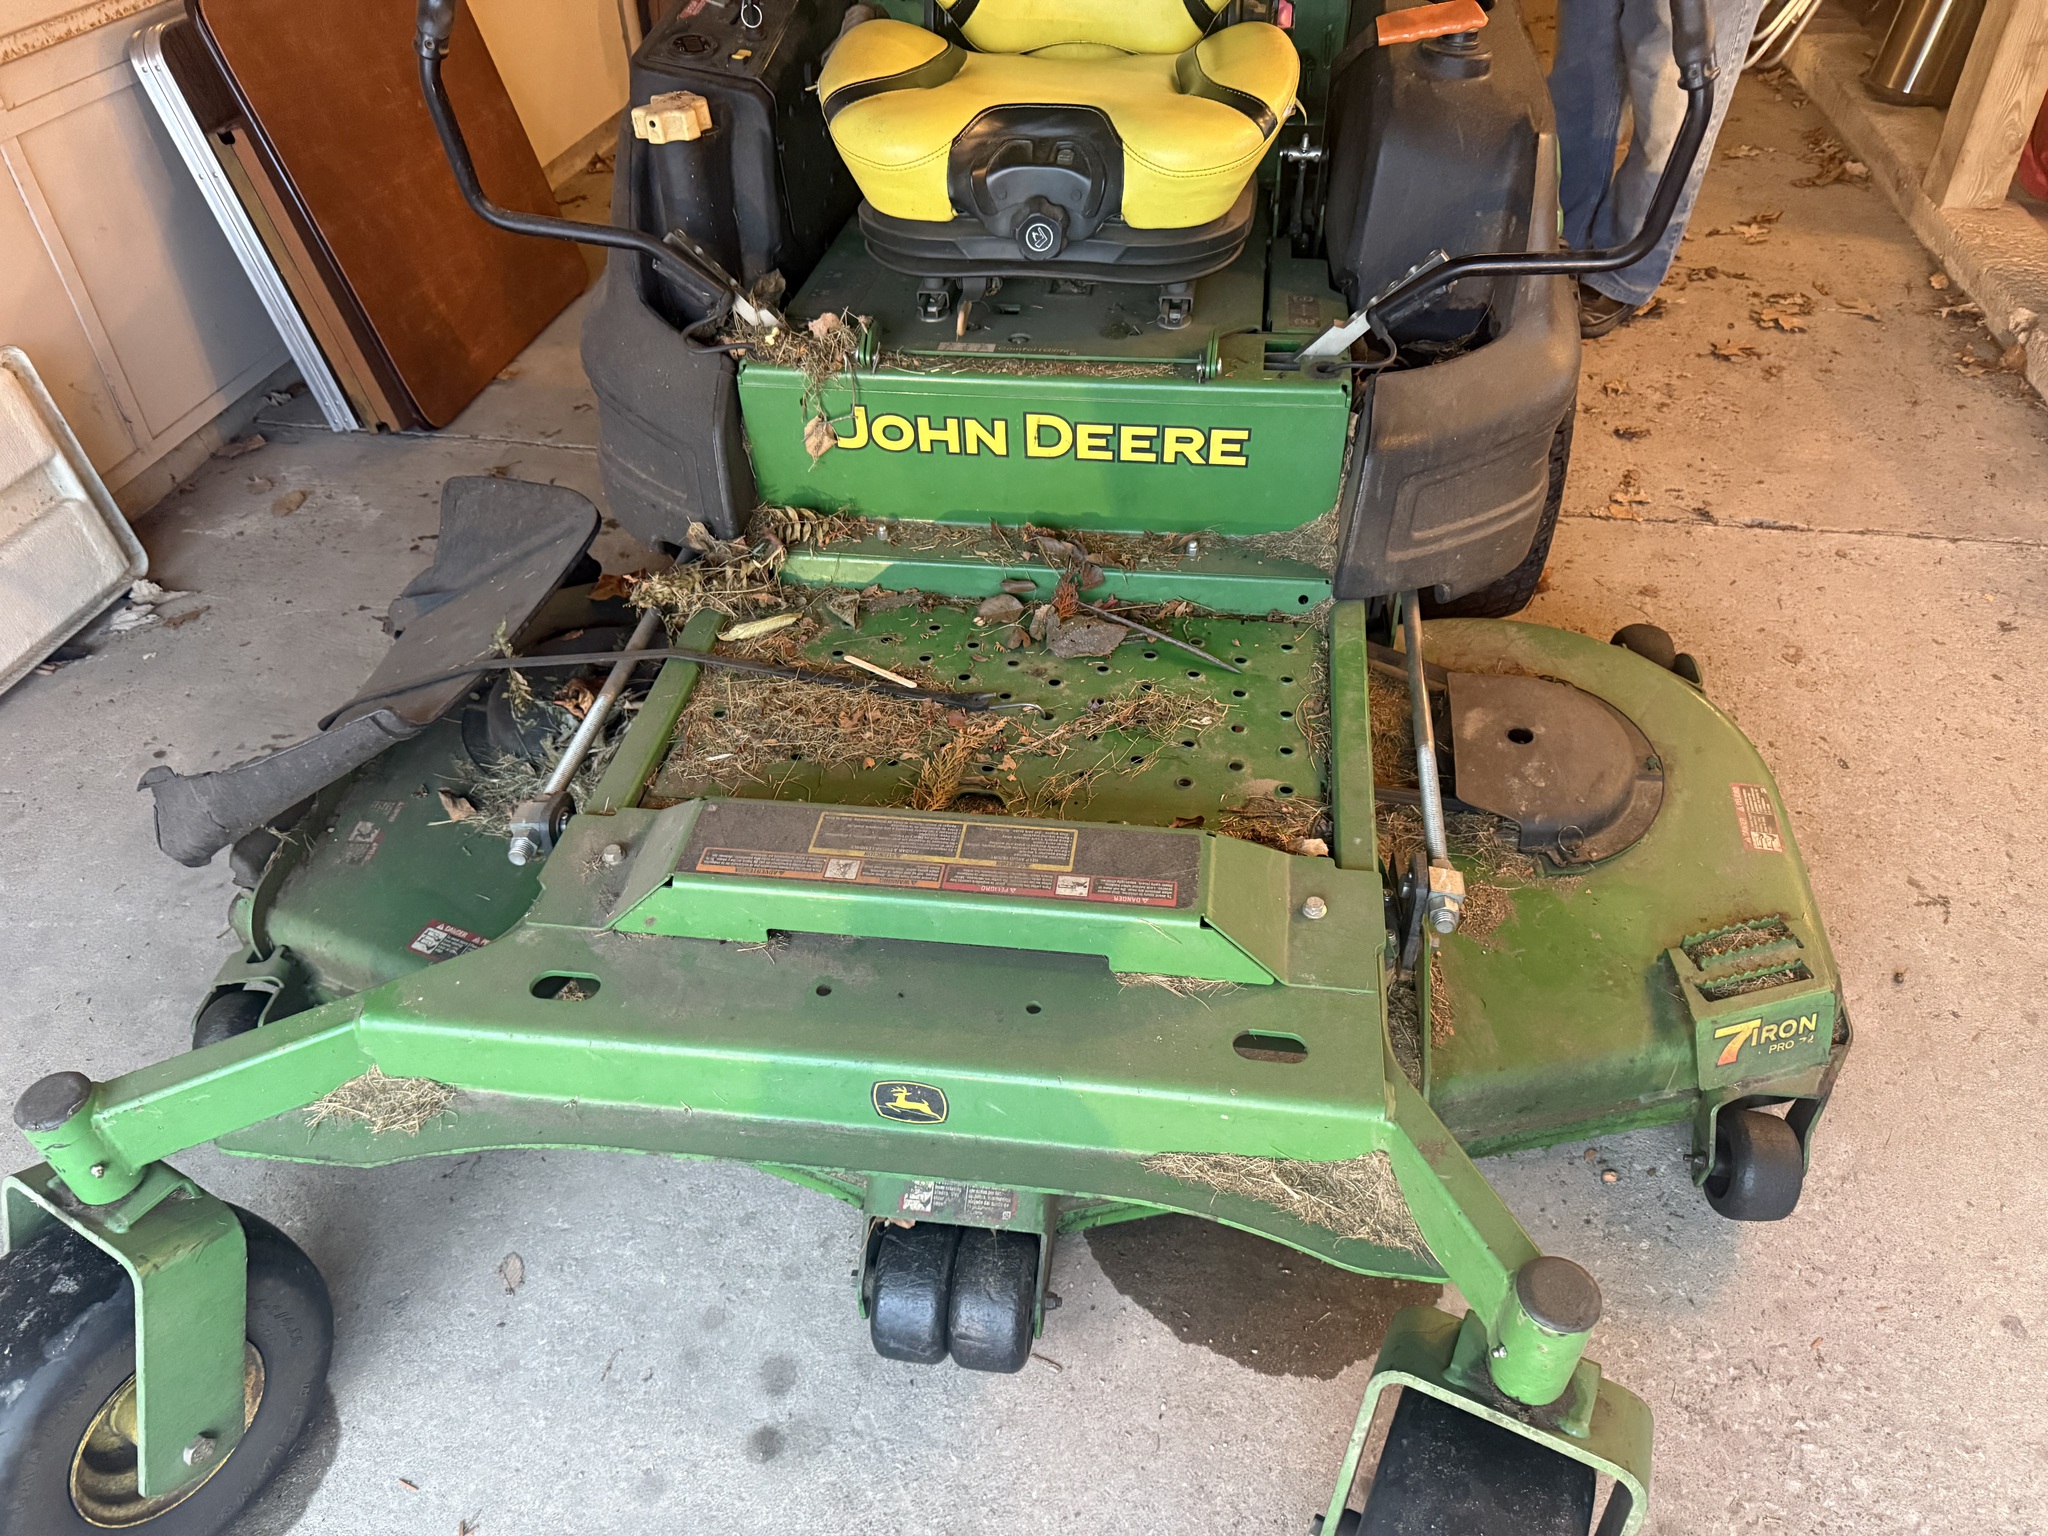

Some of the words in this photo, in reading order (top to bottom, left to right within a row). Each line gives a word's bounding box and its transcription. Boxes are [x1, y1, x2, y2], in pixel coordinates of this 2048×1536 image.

[836, 405, 1009, 457] JOHN
[1023, 412, 1251, 468] DEERE
[1768, 1040, 1795, 1054] PRO
